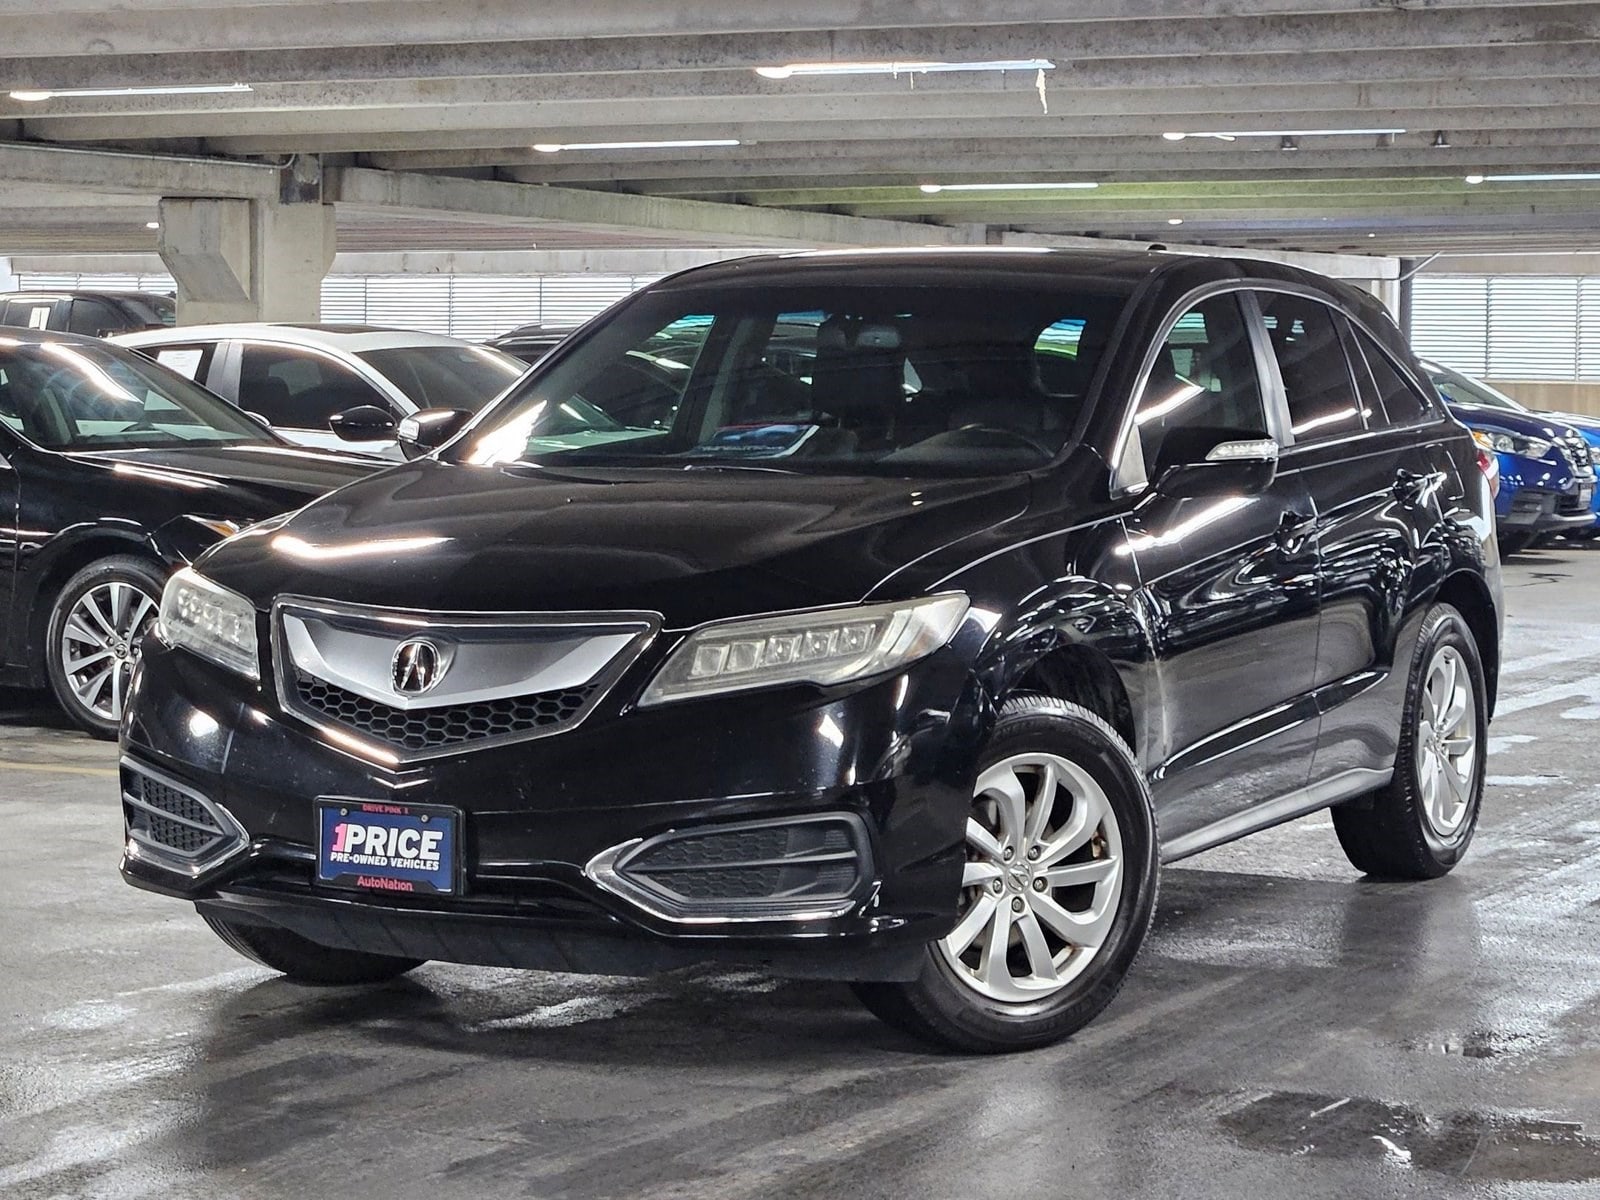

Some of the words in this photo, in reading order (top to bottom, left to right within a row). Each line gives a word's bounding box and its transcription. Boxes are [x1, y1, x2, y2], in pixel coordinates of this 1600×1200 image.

[330, 852, 388, 866] PRE-OWNED
[390, 859, 440, 871] VEHICLES
[357, 876, 413, 891] AutoNation
